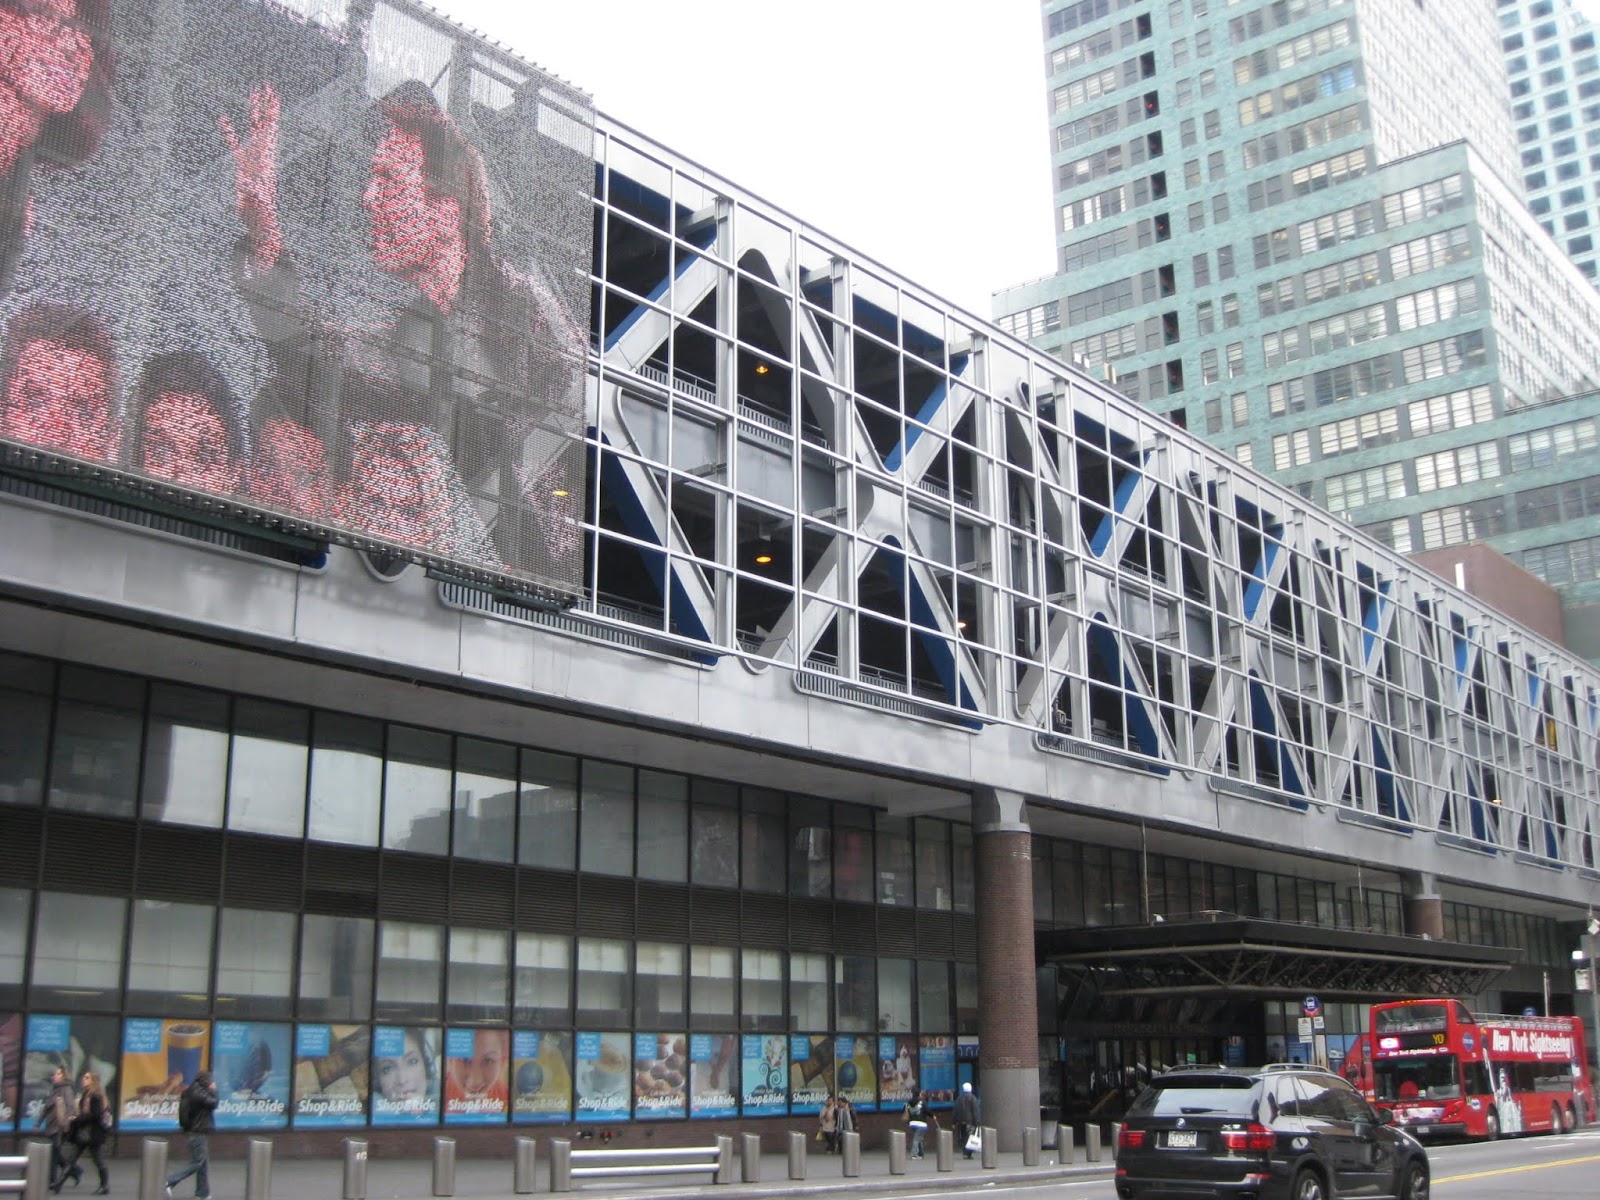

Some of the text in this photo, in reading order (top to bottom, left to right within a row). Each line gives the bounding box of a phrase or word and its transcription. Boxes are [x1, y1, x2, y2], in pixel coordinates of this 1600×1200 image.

[1493, 1029, 1571, 1060] New York Sightseeing
[376, 1098, 436, 1115] Shop&Ride
[448, 1098, 504, 1113] Shop&Ride
[515, 1098, 569, 1112] Shop&Ride
[578, 1096, 628, 1112] Shop&Ride
[637, 1095, 683, 1109] Shop&Ride
[693, 1095, 736, 1108] Shop&Ride
[743, 1093, 785, 1107] Shop&Ride
[125, 1101, 179, 1119] Shop&R
[298, 1099, 363, 1117] Shop&Ride
